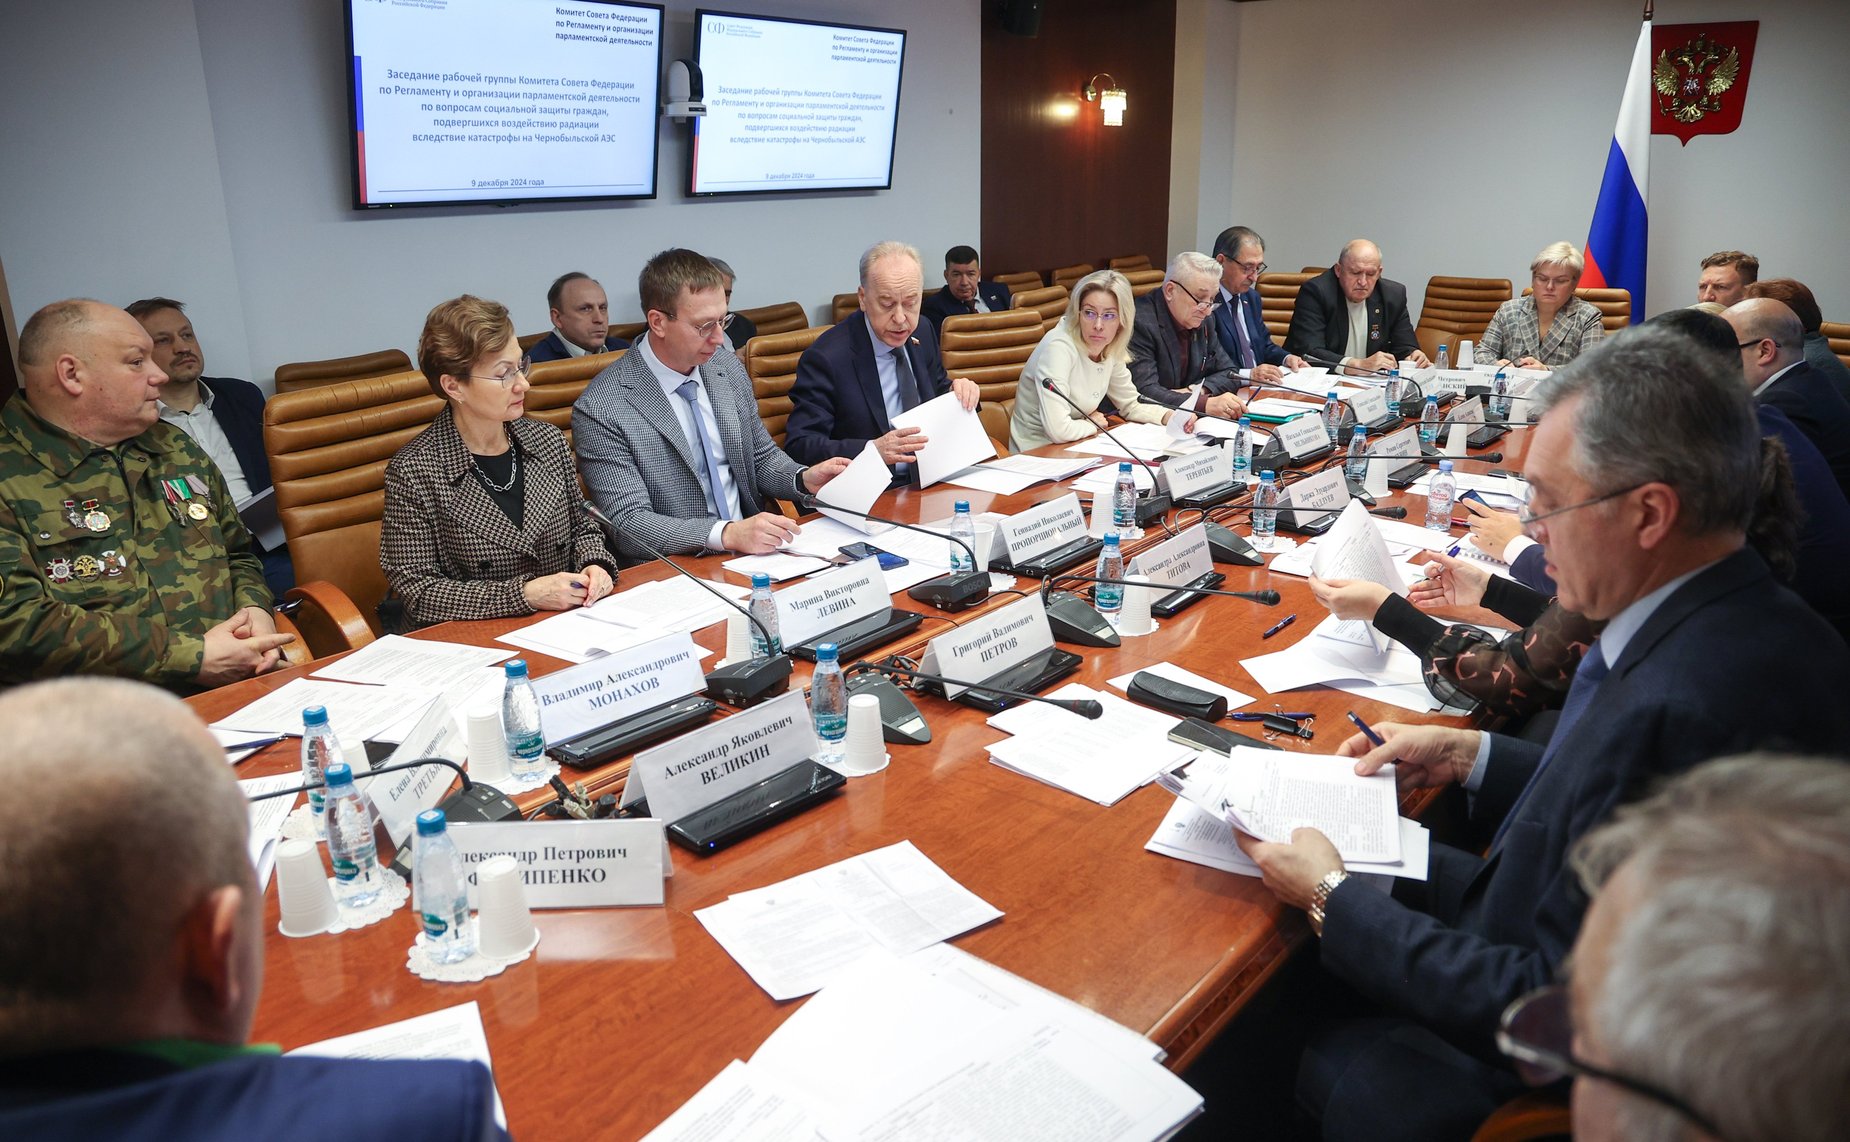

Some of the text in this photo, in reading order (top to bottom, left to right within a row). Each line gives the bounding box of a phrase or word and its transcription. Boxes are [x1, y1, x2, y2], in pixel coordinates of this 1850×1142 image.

[556, 7, 647, 23] Комитет Совета Федерации
[566, 21, 605, 32] Регламенту
[612, 26, 654, 35] организации
[556, 32, 652, 46] парламентской деятельности
[387, 69, 635, 90] Заседание рабочей группы Комитета Совета Федерации
[394, 85, 451, 98] Регламенту
[462, 89, 520, 99] организации
[522, 91, 586, 101] парламентской
[718, 85, 752, 95] Заседание
[754, 87, 780, 96] рабочей
[435, 104, 481, 113] вопросам
[484, 104, 536, 114] социальной
[573, 108, 609, 116] граждан,
[722, 99, 758, 108] Регламенту
[433, 119, 599, 129] подвергшихся воздействию радиации
[413, 134, 466, 143] вследствие
[468, 133, 520, 143] катастрофы
[535, 134, 599, 143] Чернобыльской
[478, 179, 508, 188] декабря
[1186, 466, 1214, 480] ТЕРЕНТЬЕВ
[1013, 509, 1074, 537] Геннадий Николаевич
[1143, 541, 1205, 576] Александра Александровна
[1166, 561, 1191, 580] ТИТОВА
[790, 577, 870, 612] Марина Викторовна
[962, 577, 986, 593] BOSCH
[817, 597, 856, 619] ЛЕВИНА
[952, 614, 1034, 657] Григорий Вадимович
[980, 637, 1018, 662] ПЕТРОВ
[541, 651, 690, 707] Владимир Александрович
[589, 677, 660, 711] МОНАХОВ
[664, 716, 794, 779] Александр Яковлевич
[701, 744, 771, 785] ВЕЛИКИН
[389, 774, 411, 802] Елена
[544, 846, 627, 863] Петрович
[468, 867, 606, 886] ФИПЕНКО
